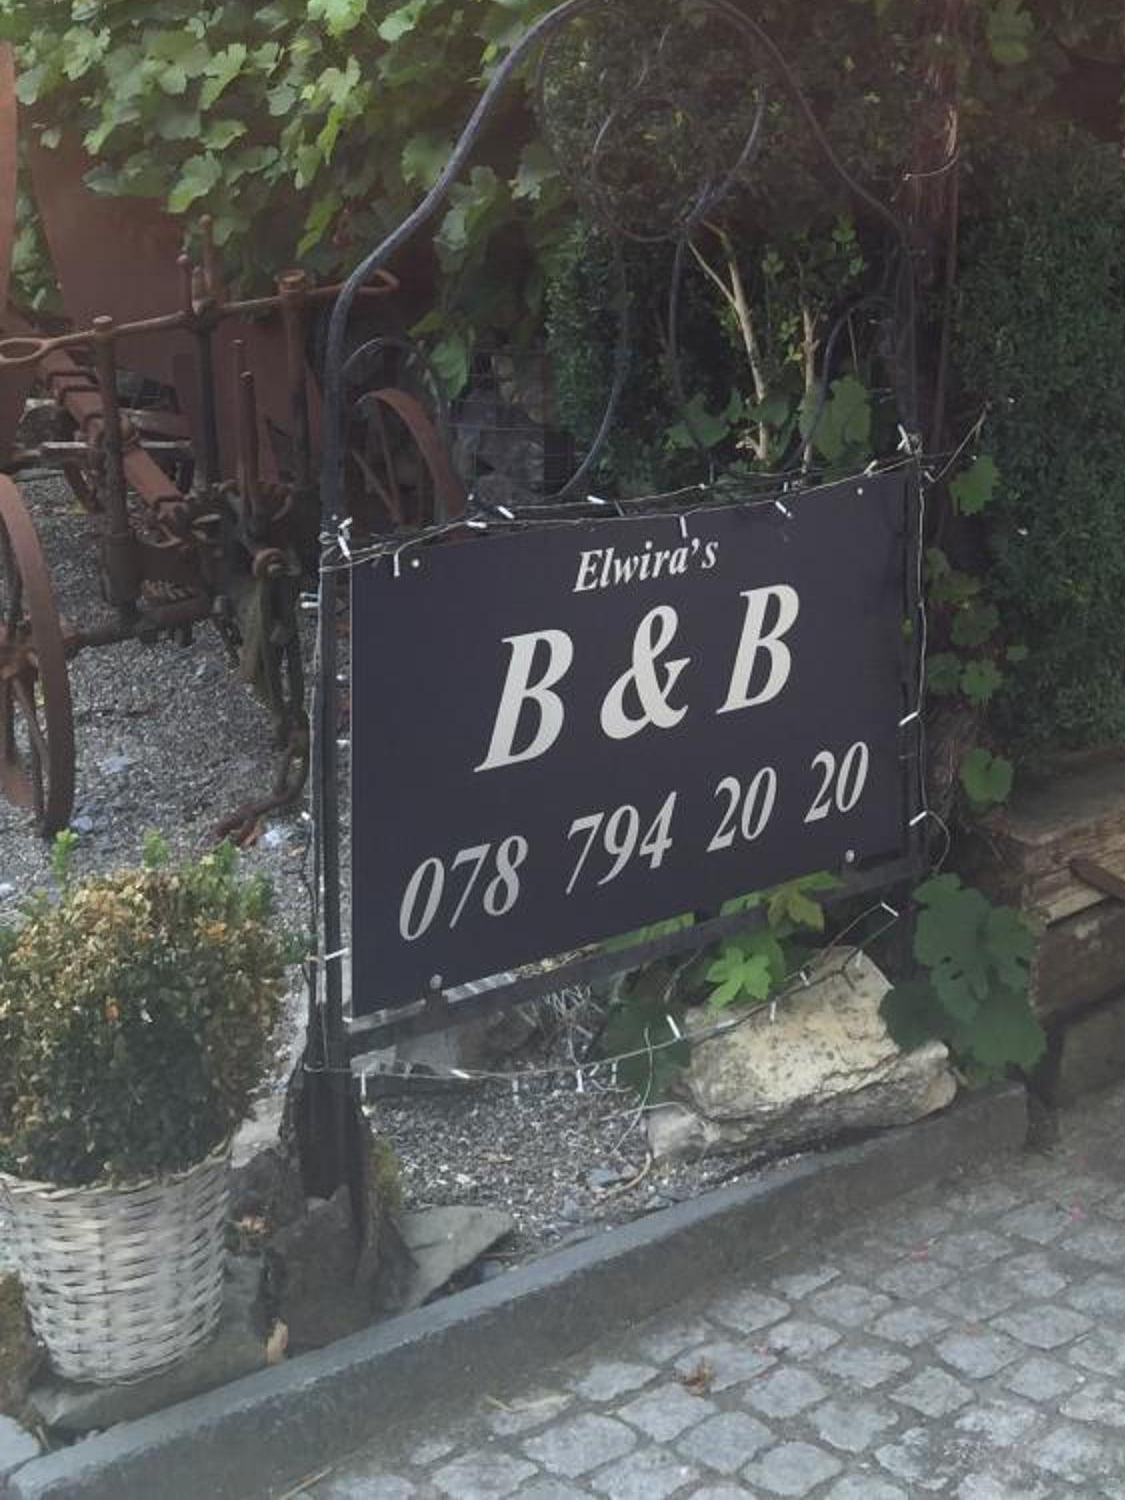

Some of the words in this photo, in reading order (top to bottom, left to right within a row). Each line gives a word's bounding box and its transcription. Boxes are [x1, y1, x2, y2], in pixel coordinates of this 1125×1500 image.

[572, 537, 719, 594] Elwira's
[473, 629, 574, 773] B
[600, 604, 692, 740] &
[715, 583, 800, 715] B
[399, 835, 529, 941] 078
[565, 790, 678, 895] 794
[706, 766, 777, 853] 20
[803, 741, 869, 823] 20
